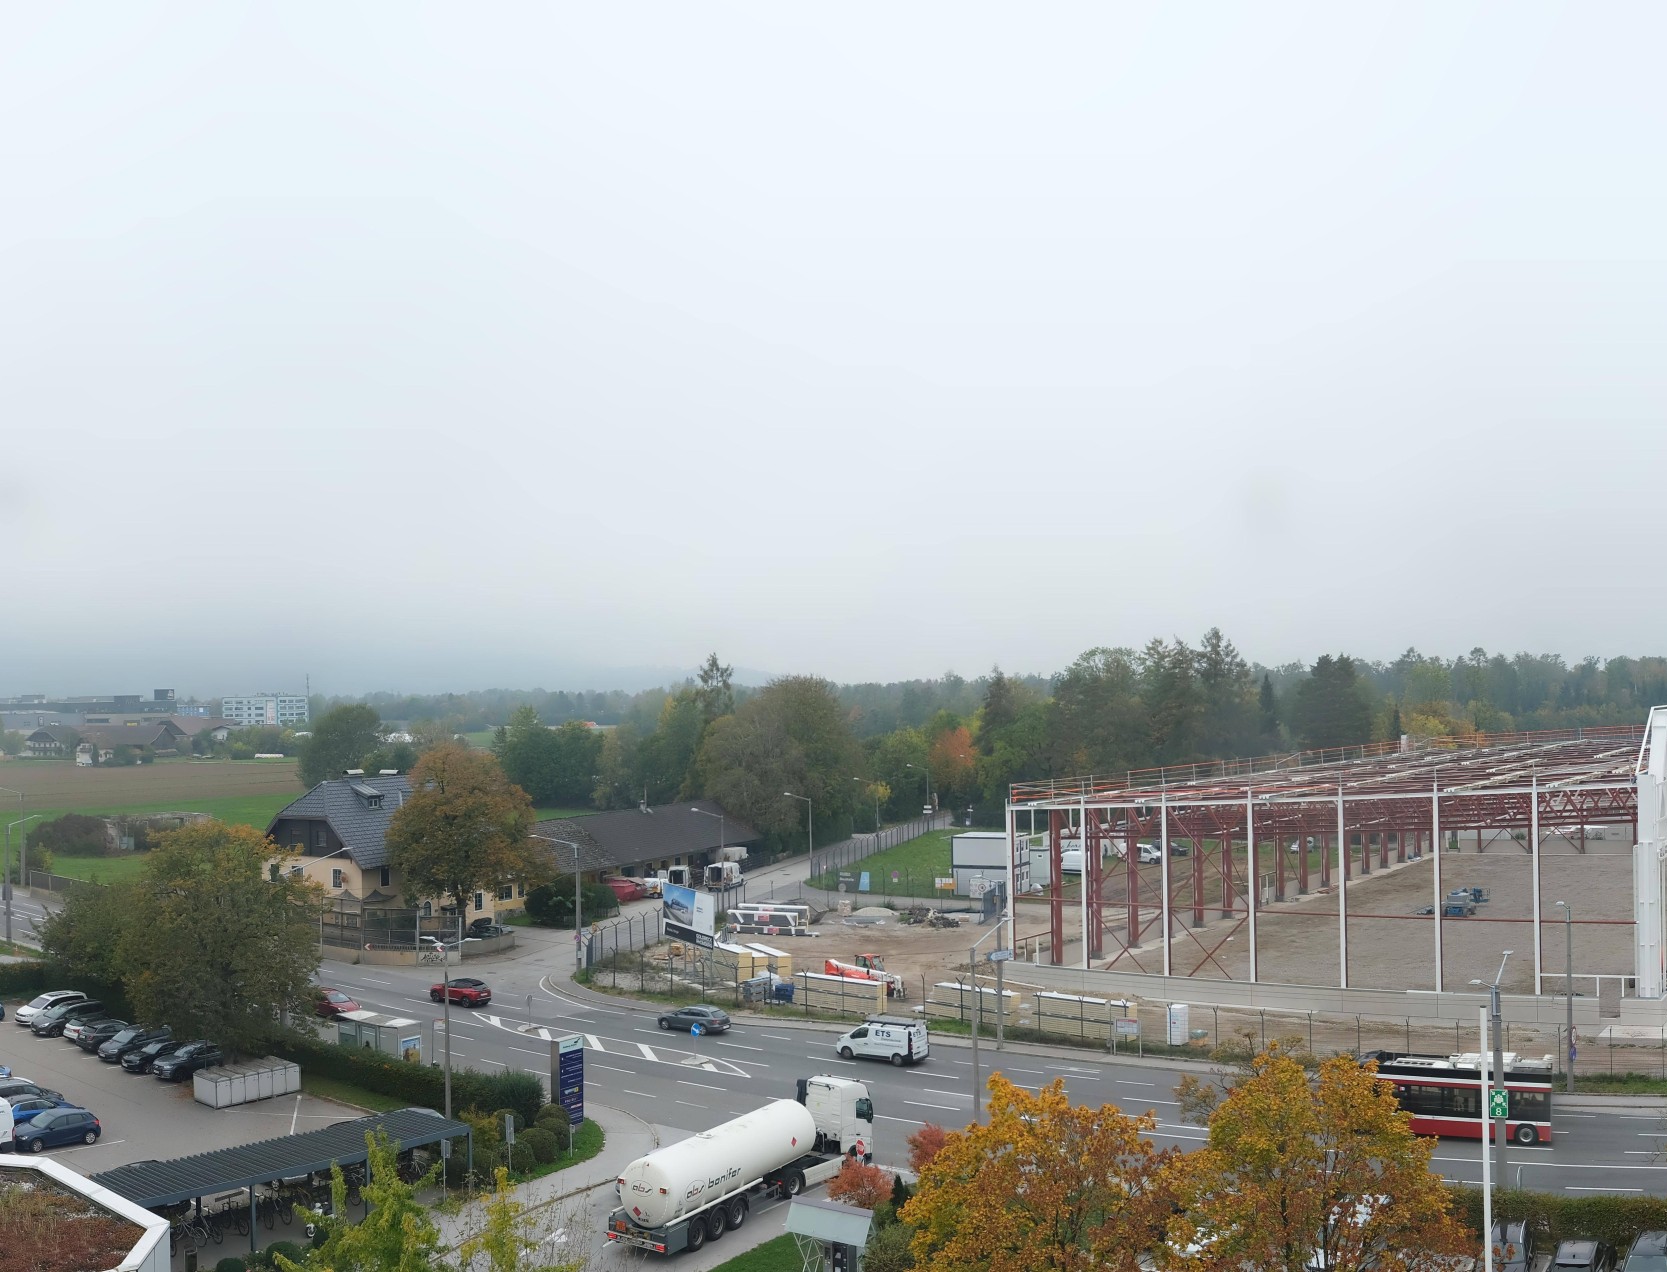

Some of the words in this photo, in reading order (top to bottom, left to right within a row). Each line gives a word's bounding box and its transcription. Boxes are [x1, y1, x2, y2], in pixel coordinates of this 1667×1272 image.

[875, 1029, 891, 1038] ETS
[1495, 1107, 1503, 1116] 8
[686, 1184, 705, 1199] abs
[707, 1167, 742, 1189] bonifer
[632, 1183, 652, 1194] abs
